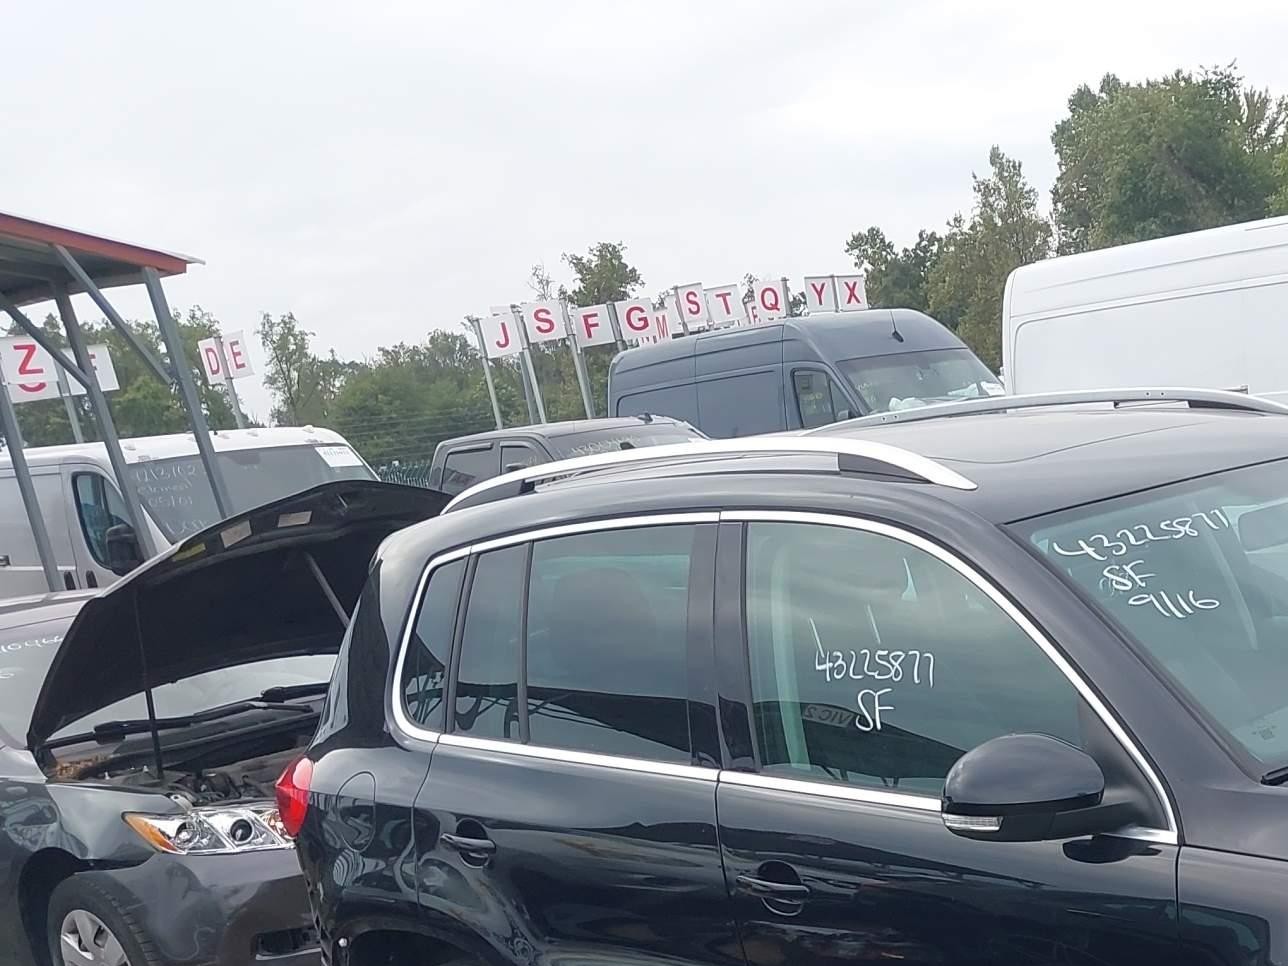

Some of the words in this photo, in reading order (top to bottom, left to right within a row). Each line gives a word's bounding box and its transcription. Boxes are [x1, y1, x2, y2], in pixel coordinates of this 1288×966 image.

[685, 290, 700, 315] S
[715, 292, 732, 315] T
[759, 287, 780, 312] Q
[810, 282, 826, 305] Y
[843, 281, 861, 305] X
[533, 308, 555, 333] S
[582, 313, 599, 338] F
[625, 306, 649, 331] G
[496, 322, 510, 348] J
[13, 344, 44, 375] Z
[205, 347, 220, 375] D
[229, 340, 246, 370] E
[815, 649, 935, 688] 43225877
[855, 688, 894, 731] SF
